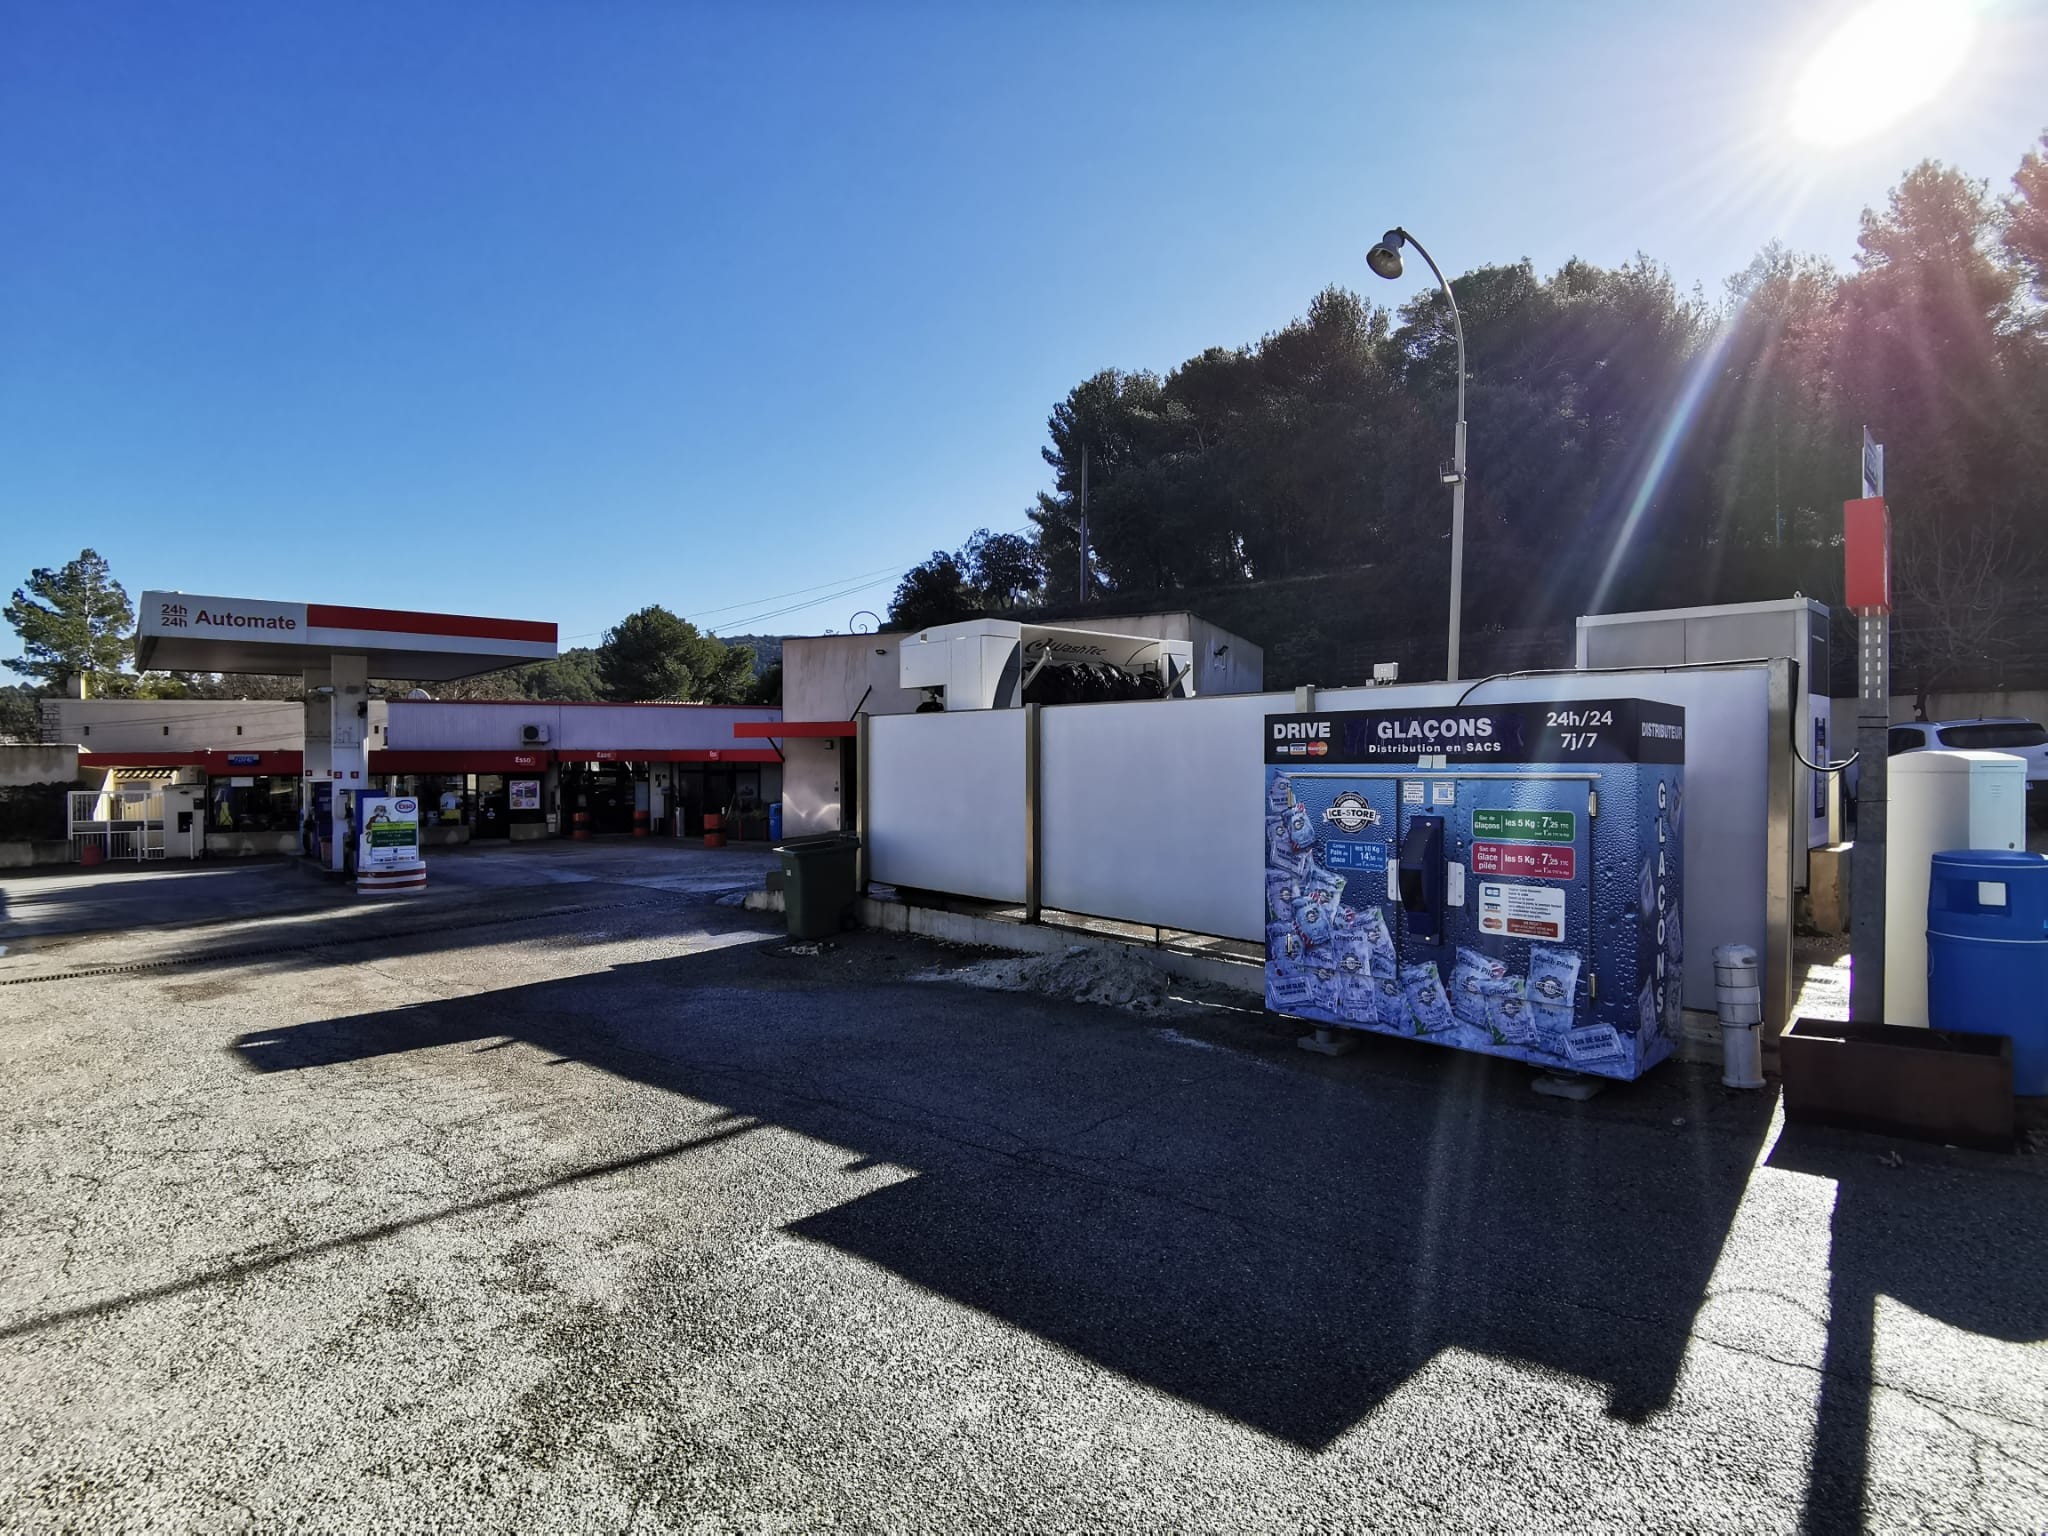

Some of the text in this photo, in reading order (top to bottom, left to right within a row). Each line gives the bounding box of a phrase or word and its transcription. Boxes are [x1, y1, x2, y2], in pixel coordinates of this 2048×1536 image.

[161, 603, 188, 615] 24h
[161, 616, 188, 628] 24h
[195, 610, 297, 630] Automate
[1546, 710, 1613, 727] 24h/24
[1273, 722, 1331, 739] DRIVE
[1377, 717, 1493, 743] GLAÇONS
[1641, 721, 1683, 740] DISTRIBUTEUR
[1368, 742, 1502, 753] Distribution en SACS
[1560, 732, 1598, 751] 7j/7
[515, 756, 532, 764] Esso
[1328, 809, 1375, 819] ICE-STORE
[1474, 822, 1501, 830] Glaçons
[1505, 818, 1517, 828] les
[1517, 819, 1524, 828] 5
[1525, 819, 1536, 829] Kg
[1477, 852, 1498, 861] Glace
[1504, 854, 1516, 863] les
[1517, 855, 1524, 863] 5
[1524, 855, 1535, 866] Kg
[1478, 861, 1497, 871] pilée
